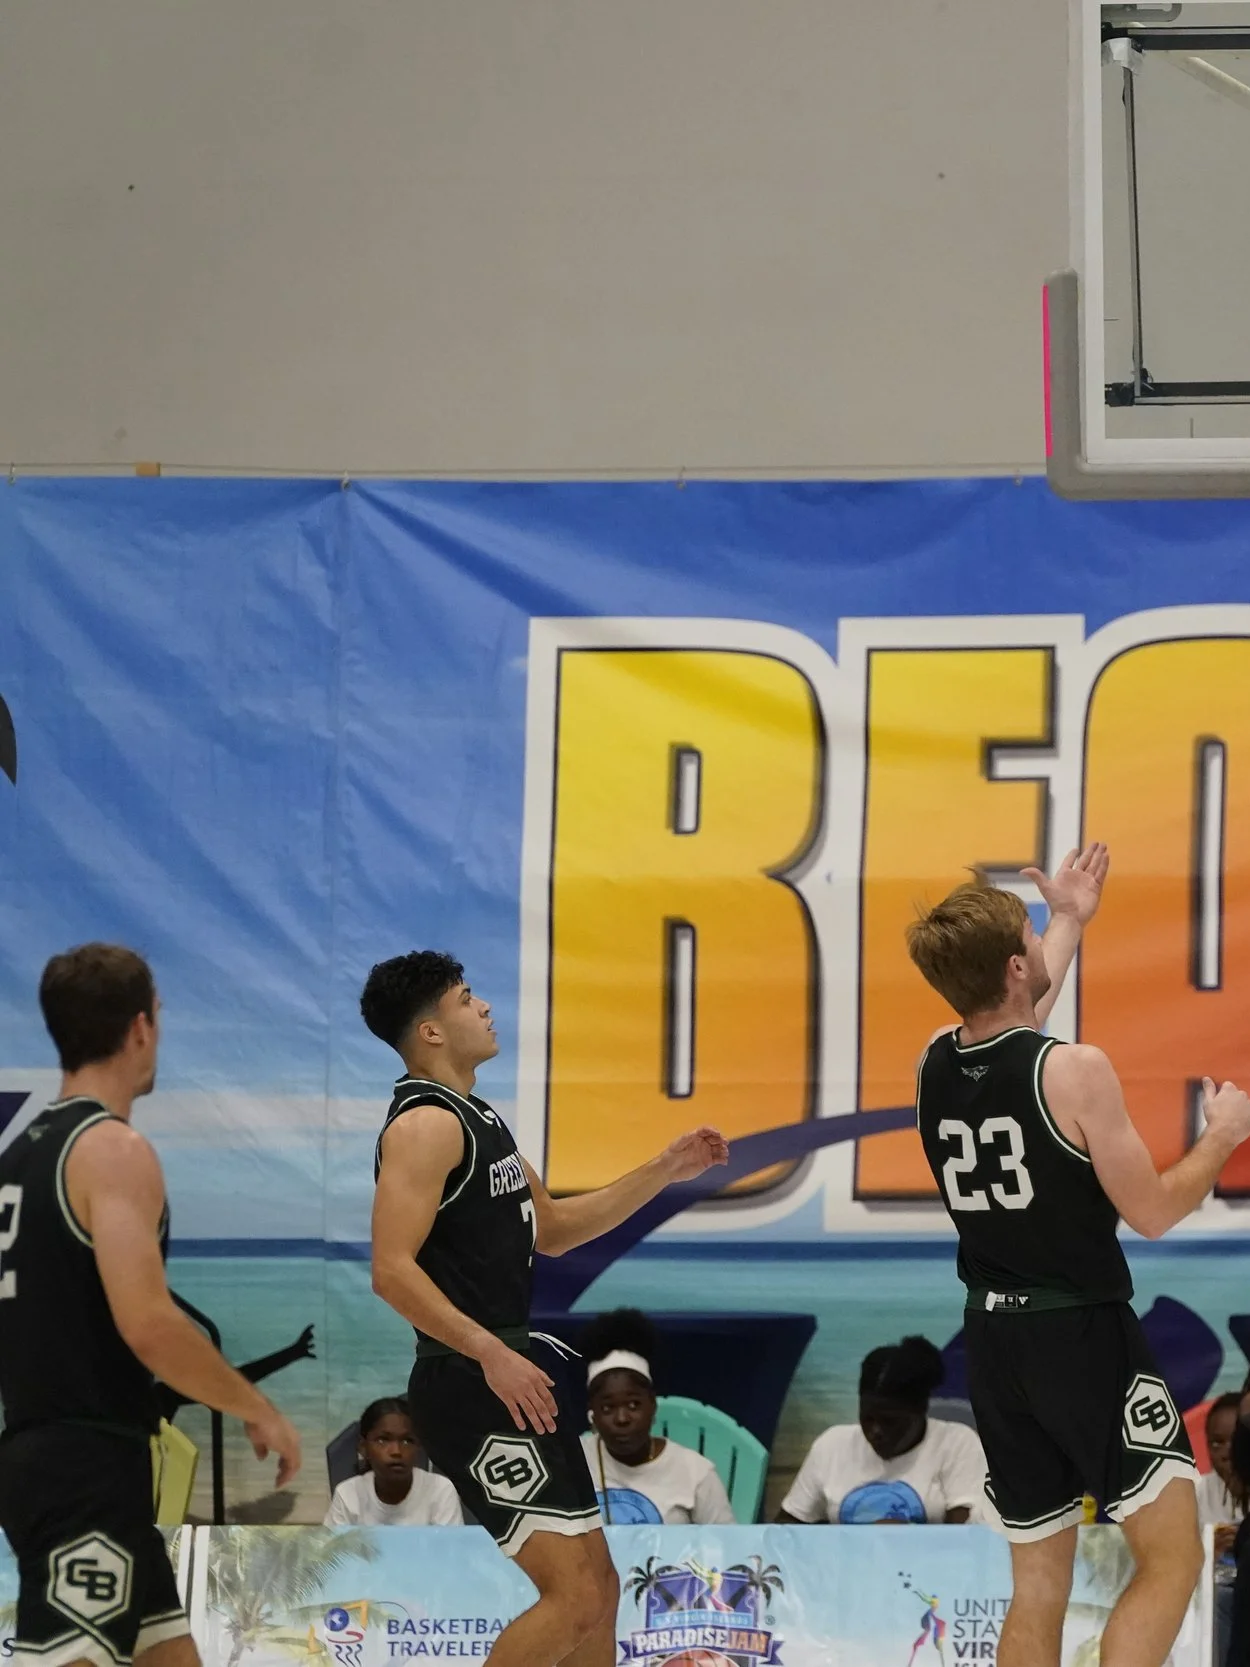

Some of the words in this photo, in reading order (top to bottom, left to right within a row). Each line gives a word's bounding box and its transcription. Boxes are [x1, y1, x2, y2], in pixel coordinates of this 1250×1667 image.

[938, 1116, 1034, 1211] 23
[1129, 1395, 1171, 1432] GB
[484, 1454, 533, 1489] GB
[66, 1556, 118, 1601] GB
[953, 1599, 1012, 1617] UNIT
[387, 1618, 513, 1635] BASKETBA
[953, 1641, 995, 1659] VIR
